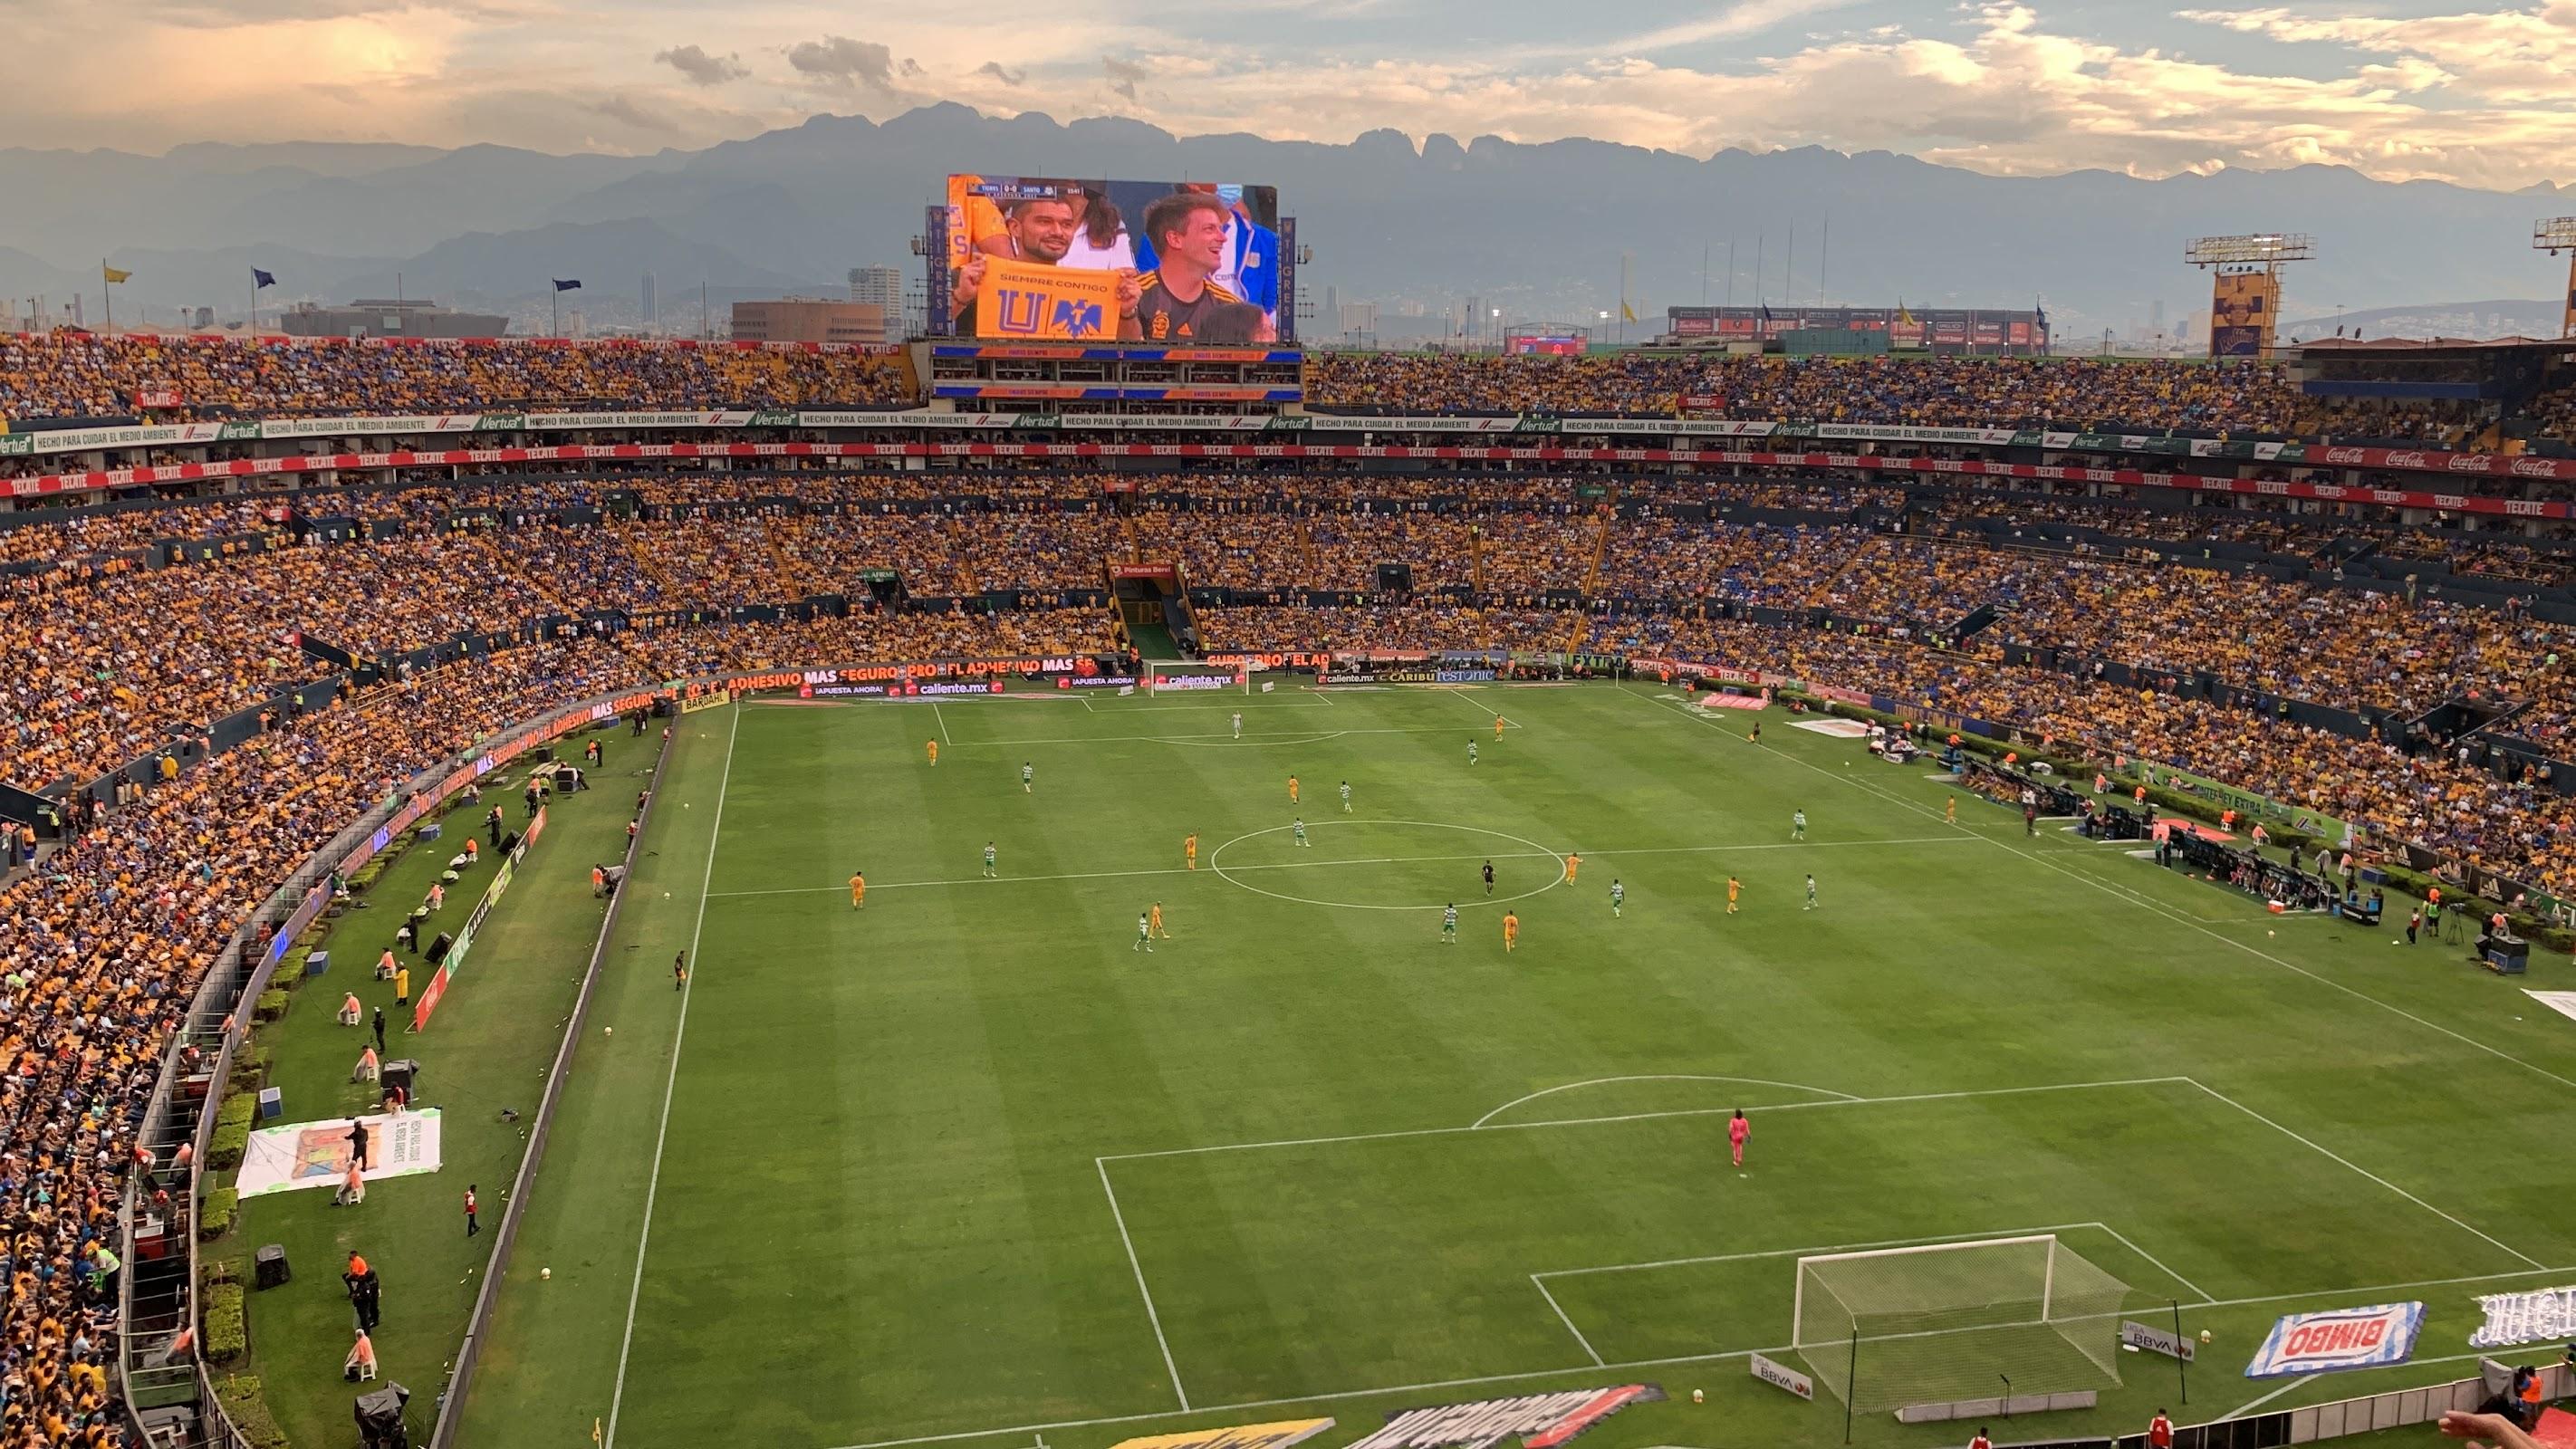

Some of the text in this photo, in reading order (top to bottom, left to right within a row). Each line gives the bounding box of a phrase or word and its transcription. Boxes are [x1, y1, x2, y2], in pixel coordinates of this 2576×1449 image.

[934, 229, 945, 309] TIGRES
[1000, 273, 1109, 293] SIEMPRE CONTIGO
[1283, 239, 1293, 317] TIGRES
[141, 392, 171, 406] TECATE
[1687, 398, 1711, 407] TECATE
[481, 417, 517, 429] Vertua
[559, 417, 581, 426] PARA
[582, 417, 613, 425] CUIDAR
[617, 416, 626, 424] EL
[629, 416, 655, 424] MEDIO
[657, 415, 699, 424] AMBIENTE
[755, 414, 792, 426] Vertua
[804, 415, 968, 425] HECHO PARA CUIDAR EL MEDIO AMBIENTE
[1020, 415, 1054, 427] Vertua
[1066, 417, 1091, 426] HECHO
[1093, 417, 1114, 426] PARA
[1147, 417, 1155, 427] EL
[1158, 417, 1182, 427] MEDIO
[1184, 418, 1222, 427] AMBIENTE
[1272, 417, 1306, 429] Vertua
[1316, 419, 1341, 427] HECHO
[1364, 420, 1392, 428] CUIDAR
[1395, 420, 1404, 428] EL
[1406, 420, 1429, 428] MEDIO
[1432, 420, 1470, 428] AMBIENTE
[1521, 420, 1555, 431] Vertua
[223, 425, 255, 438] Vertua
[265, 420, 426, 435] HECHO PARA CUIDAR EL MEDIO AMBIENTE
[1566, 422, 1591, 430] HECHO
[1594, 422, 1615, 430] PARA
[1648, 423, 1657, 431] EL
[1659, 423, 1684, 431] MEDIO
[1686, 424, 1725, 432] AMBIENTE
[1776, 425, 1812, 437] Vertua
[38, 428, 178, 447] HECHO PARA CUIDAR EL MEDIO AMBIENTE
[1821, 427, 1980, 440] HECHO PARA CUIDAR EL MEDIO AMBIENTE
[524, 447, 558, 459] TECATE
[582, 445, 616, 457] TECATE
[696, 444, 730, 455] TECATE
[754, 444, 787, 455] TECATE
[874, 444, 907, 455] TECATE
[939, 444, 971, 455] TECATE
[993, 444, 1024, 455] TECATE
[1099, 444, 1129, 455] TECATE
[1150, 444, 1181, 455] TECATE
[1254, 445, 1283, 456] TECATE
[1305, 446, 1335, 456] TECATE
[1408, 446, 1437, 457] TECATE
[1459, 447, 1489, 458] TECATE
[1562, 449, 1594, 459] TECATE
[1615, 449, 1648, 460] TECATE
[304, 456, 336, 468] TECATE
[413, 451, 446, 464] TECATE
[1721, 452, 1753, 463] TECATE
[1774, 454, 1806, 465] TECATE
[1880, 457, 1912, 468] TECATE
[201, 461, 231, 475] TECATE
[252, 459, 283, 472] TECATE
[1932, 460, 1964, 472] TECATE
[2034, 465, 2065, 478] TECATE
[59, 474, 87, 489] TECATE
[106, 469, 134, 484] TECATE
[2085, 469, 2116, 482] TECATE
[11, 478, 40, 494] TECATE
[2200, 476, 2234, 490] TECATE
[2255, 481, 2290, 494] TECATE
[2314, 485, 2341, 496] TECATE
[2435, 494, 2464, 507] TECATE
[2504, 500, 2545, 515] TECATE
[728, 672, 802, 691] ADHESIVO
[804, 669, 837, 684] MAS
[907, 664, 937, 677] PRO
[1043, 657, 1073, 672] MAS
[1327, 673, 1375, 683] caliente.mx
[920, 683, 987, 695] caliente.mx
[686, 693, 725, 710] BARDAHL
[592, 701, 613, 720] MAS
[476, 754, 494, 776] MAS
[2134, 1333, 2171, 1351] BBVA
[2284, 1319, 2389, 1357] BIMBO
[1761, 1367, 1793, 1387] BBVA
